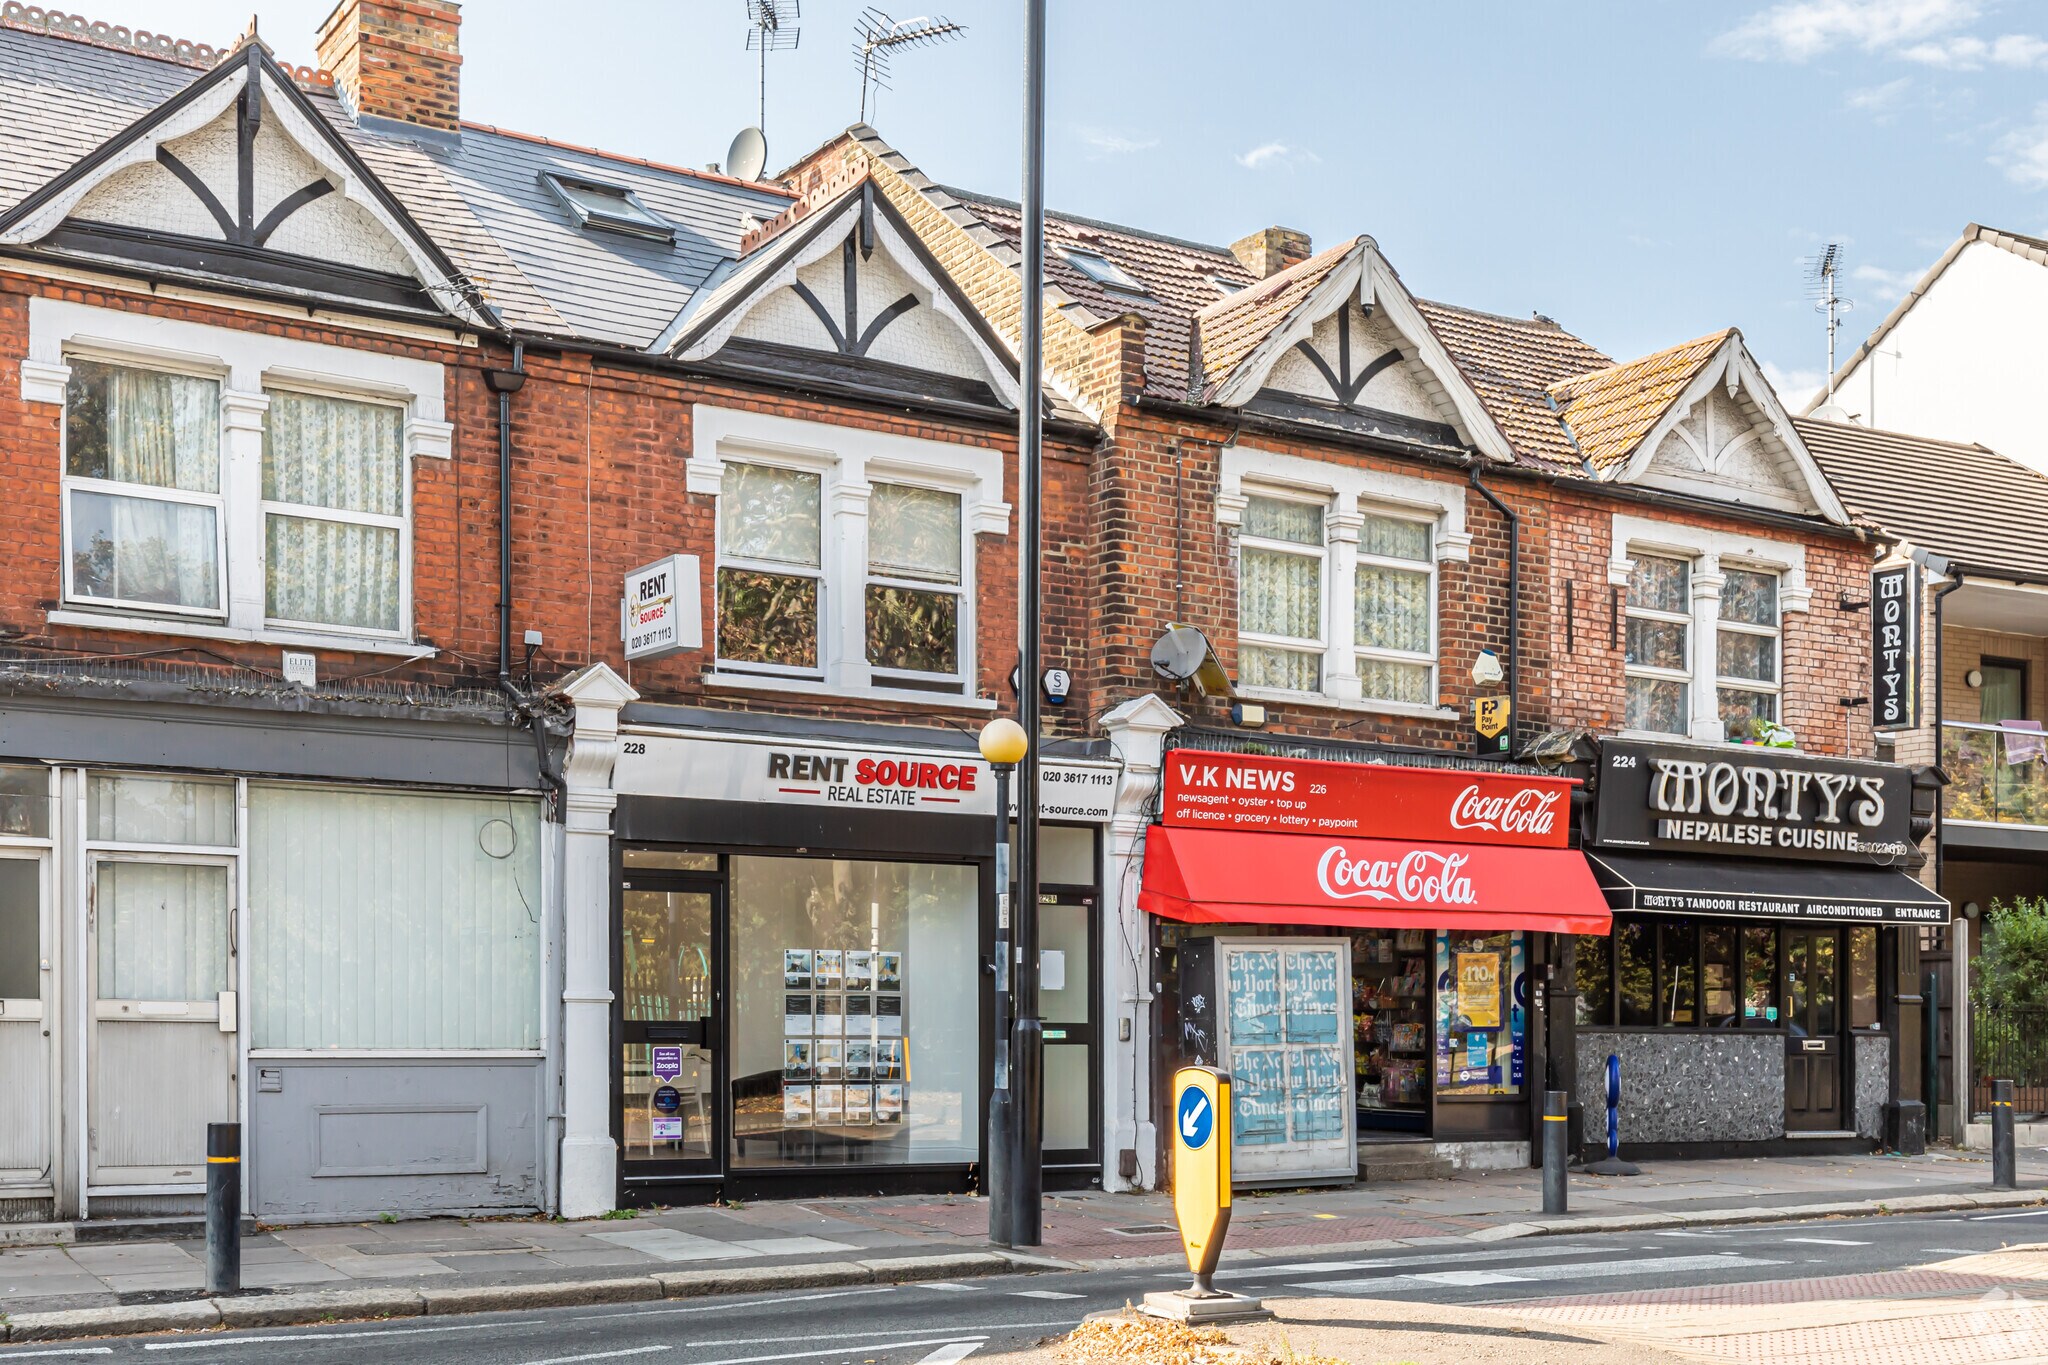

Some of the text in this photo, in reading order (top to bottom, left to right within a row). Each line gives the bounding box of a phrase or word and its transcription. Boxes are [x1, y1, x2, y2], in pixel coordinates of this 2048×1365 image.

[640, 573, 666, 601] RENT
[640, 606, 664, 624] SOURCE
[632, 626, 672, 649] 020 3617 1113
[1880, 574, 1904, 721] MONTYS
[289, 658, 314, 666] ELITE
[1482, 716, 1492, 724] Pay
[1482, 722, 1498, 730] Point
[624, 742, 646, 754] 228
[768, 752, 978, 791] RENT SOURCE
[1612, 756, 1636, 768] 224
[1043, 771, 1113, 786] 020 3617 1113
[1180, 764, 1295, 792] V.K NEWS
[828, 786, 916, 806] REAL ESTATE
[1310, 784, 1327, 794] 226
[1177, 794, 1307, 810] newsagent oyster top up
[1450, 784, 1562, 834] Coca-Cola
[1176, 808, 1358, 828] off licence grocery lottery paypoint
[1666, 820, 1772, 846] NEPALESE
[1778, 828, 1858, 852] CUISINE
[1316, 845, 1478, 904] Coca-Cola
[1686, 898, 1736, 910] TANDOORI
[1738, 900, 1800, 914] RESTAURANT
[1806, 904, 1883, 917] AIRCONDITIONED
[1895, 908, 1941, 919] ENTRANCE
[1230, 952, 1256, 972] The
[1286, 952, 1312, 972] The
[1301, 973, 1336, 992] York
[1234, 1051, 1260, 1072] The
[1292, 1049, 1316, 1068] The
